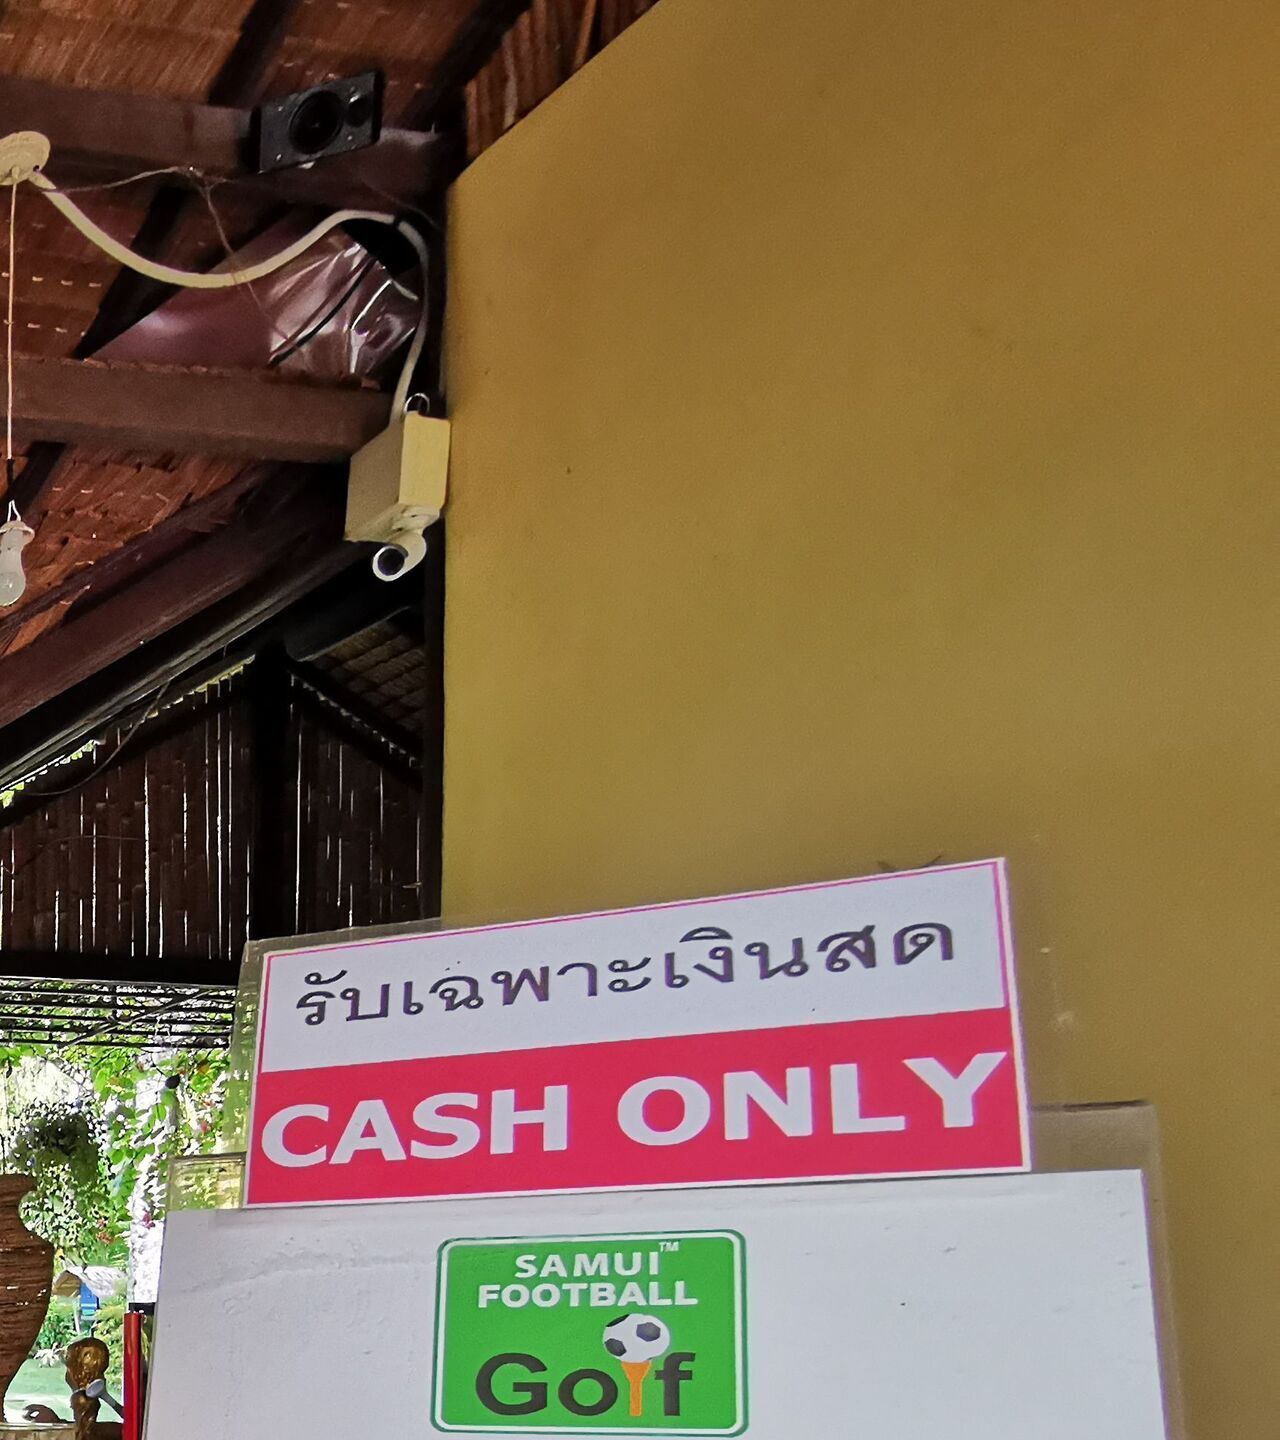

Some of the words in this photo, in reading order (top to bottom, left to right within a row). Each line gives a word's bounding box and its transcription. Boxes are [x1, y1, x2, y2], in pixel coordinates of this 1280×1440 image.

[295, 918, 955, 1028] รับเฉพาะเงินสด
[260, 1084, 568, 1168] CASH
[616, 1050, 1008, 1147] ONLY
[477, 1280, 698, 1309] FOOTBALL
[514, 1251, 660, 1278] SAMUI
[474, 1351, 697, 1417] Golf
